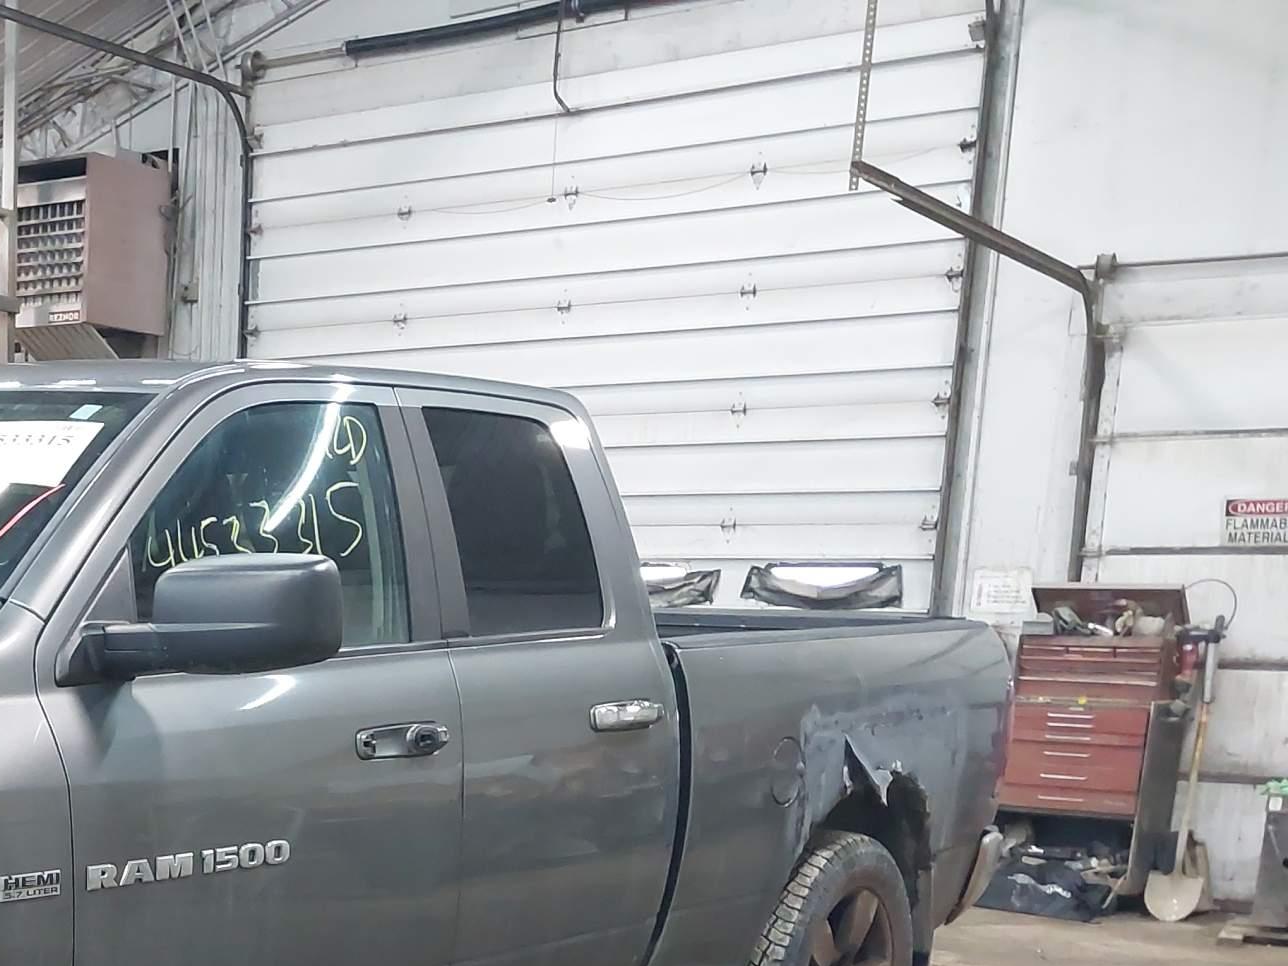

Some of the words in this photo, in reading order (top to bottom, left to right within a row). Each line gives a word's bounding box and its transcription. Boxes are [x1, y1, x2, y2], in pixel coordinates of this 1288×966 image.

[87, 852, 194, 891] RAM
[202, 840, 291, 873] 1500
[4, 873, 60, 891] HEMI
[26, 886, 59, 897] LITER
